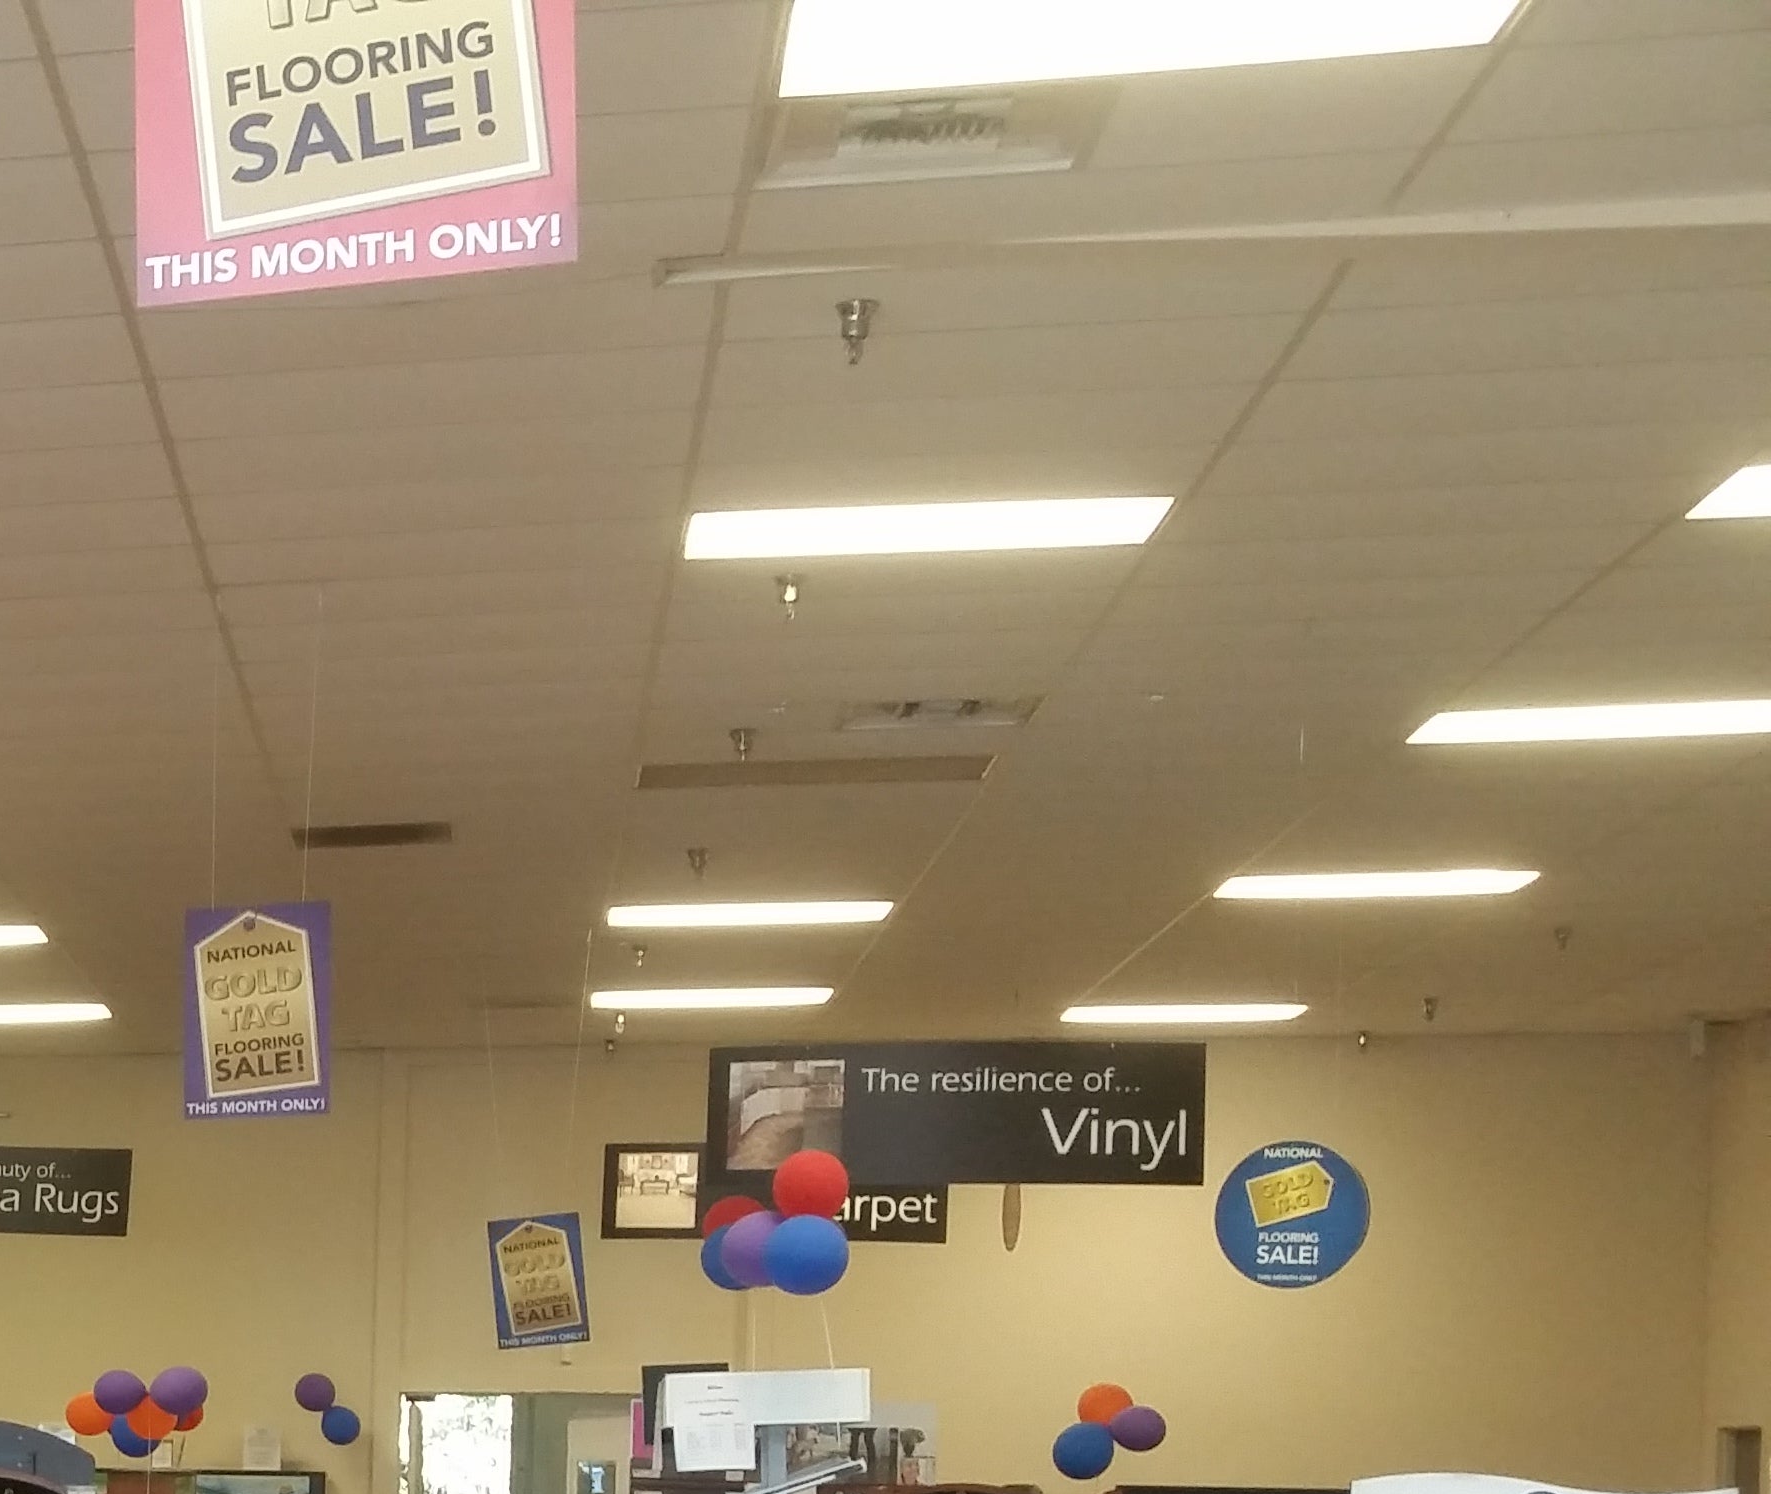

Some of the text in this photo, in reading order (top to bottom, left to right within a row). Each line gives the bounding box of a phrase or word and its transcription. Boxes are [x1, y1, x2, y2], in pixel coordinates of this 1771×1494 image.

[226, 21, 495, 107] FLOORING
[228, 69, 498, 184] SALE!
[145, 214, 562, 289] THIS MONTH ONLY!
[206, 939, 297, 964] NATIONAL
[204, 966, 303, 1001] GOLD
[221, 1000, 291, 1032] TAG
[214, 1033, 305, 1057] FLOORING
[215, 1049, 305, 1083] SALE!
[862, 1065, 1143, 1094] The resilience of...
[186, 1097, 325, 1116] THIS MONTH ONLY!
[1041, 1107, 1189, 1172] Vinyl
[1263, 1147, 1323, 1159] NATIONAL
[33, 1161, 72, 1179] of...
[33, 1182, 120, 1223] Rugs
[832, 1193, 938, 1231] arpet
[503, 1237, 560, 1254] NATIONAL
[1258, 1231, 1320, 1243] FLOORING
[1256, 1245, 1319, 1265] SALE!
[515, 1303, 572, 1326] SALE!
[521, 1334, 557, 1346] MONTH
